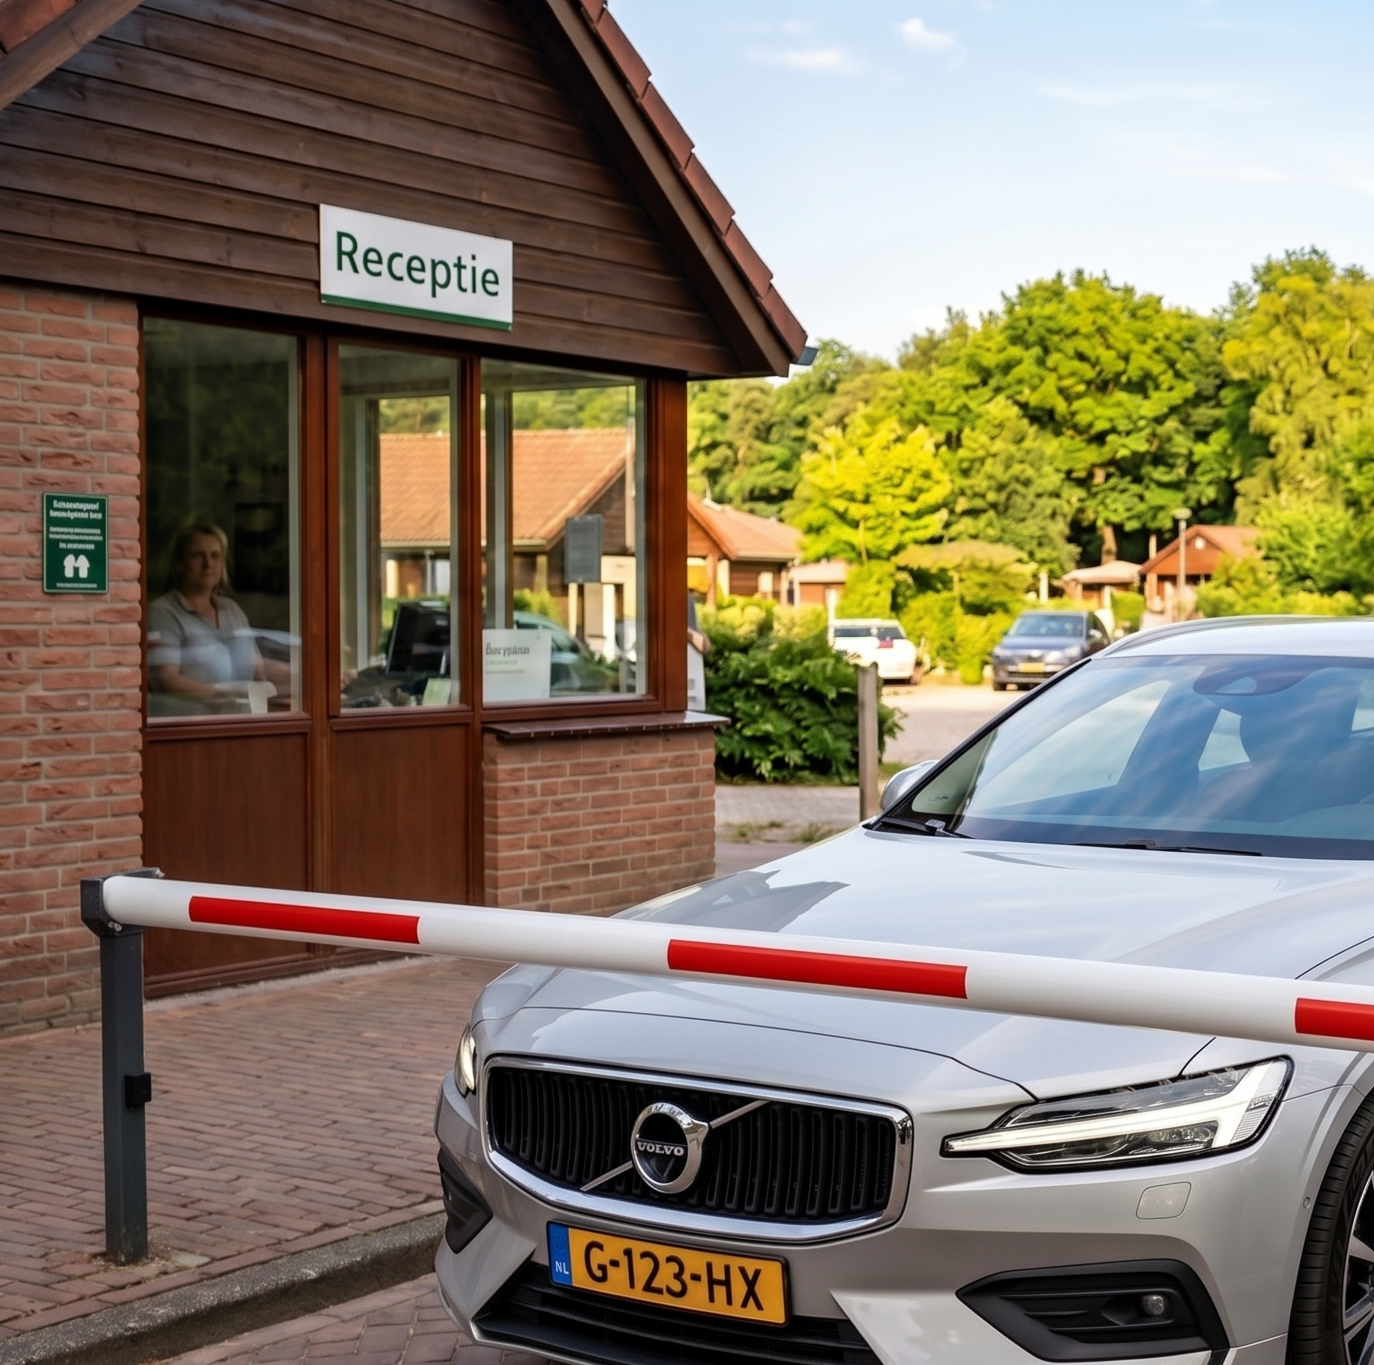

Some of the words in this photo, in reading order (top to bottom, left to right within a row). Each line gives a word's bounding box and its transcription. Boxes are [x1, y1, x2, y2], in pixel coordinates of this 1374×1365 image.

[336, 230, 499, 298] Receptie
[636, 1141, 685, 1157] VOLVO
[555, 1260, 570, 1275] NL
[584, 1240, 765, 1311] G-123-HX
